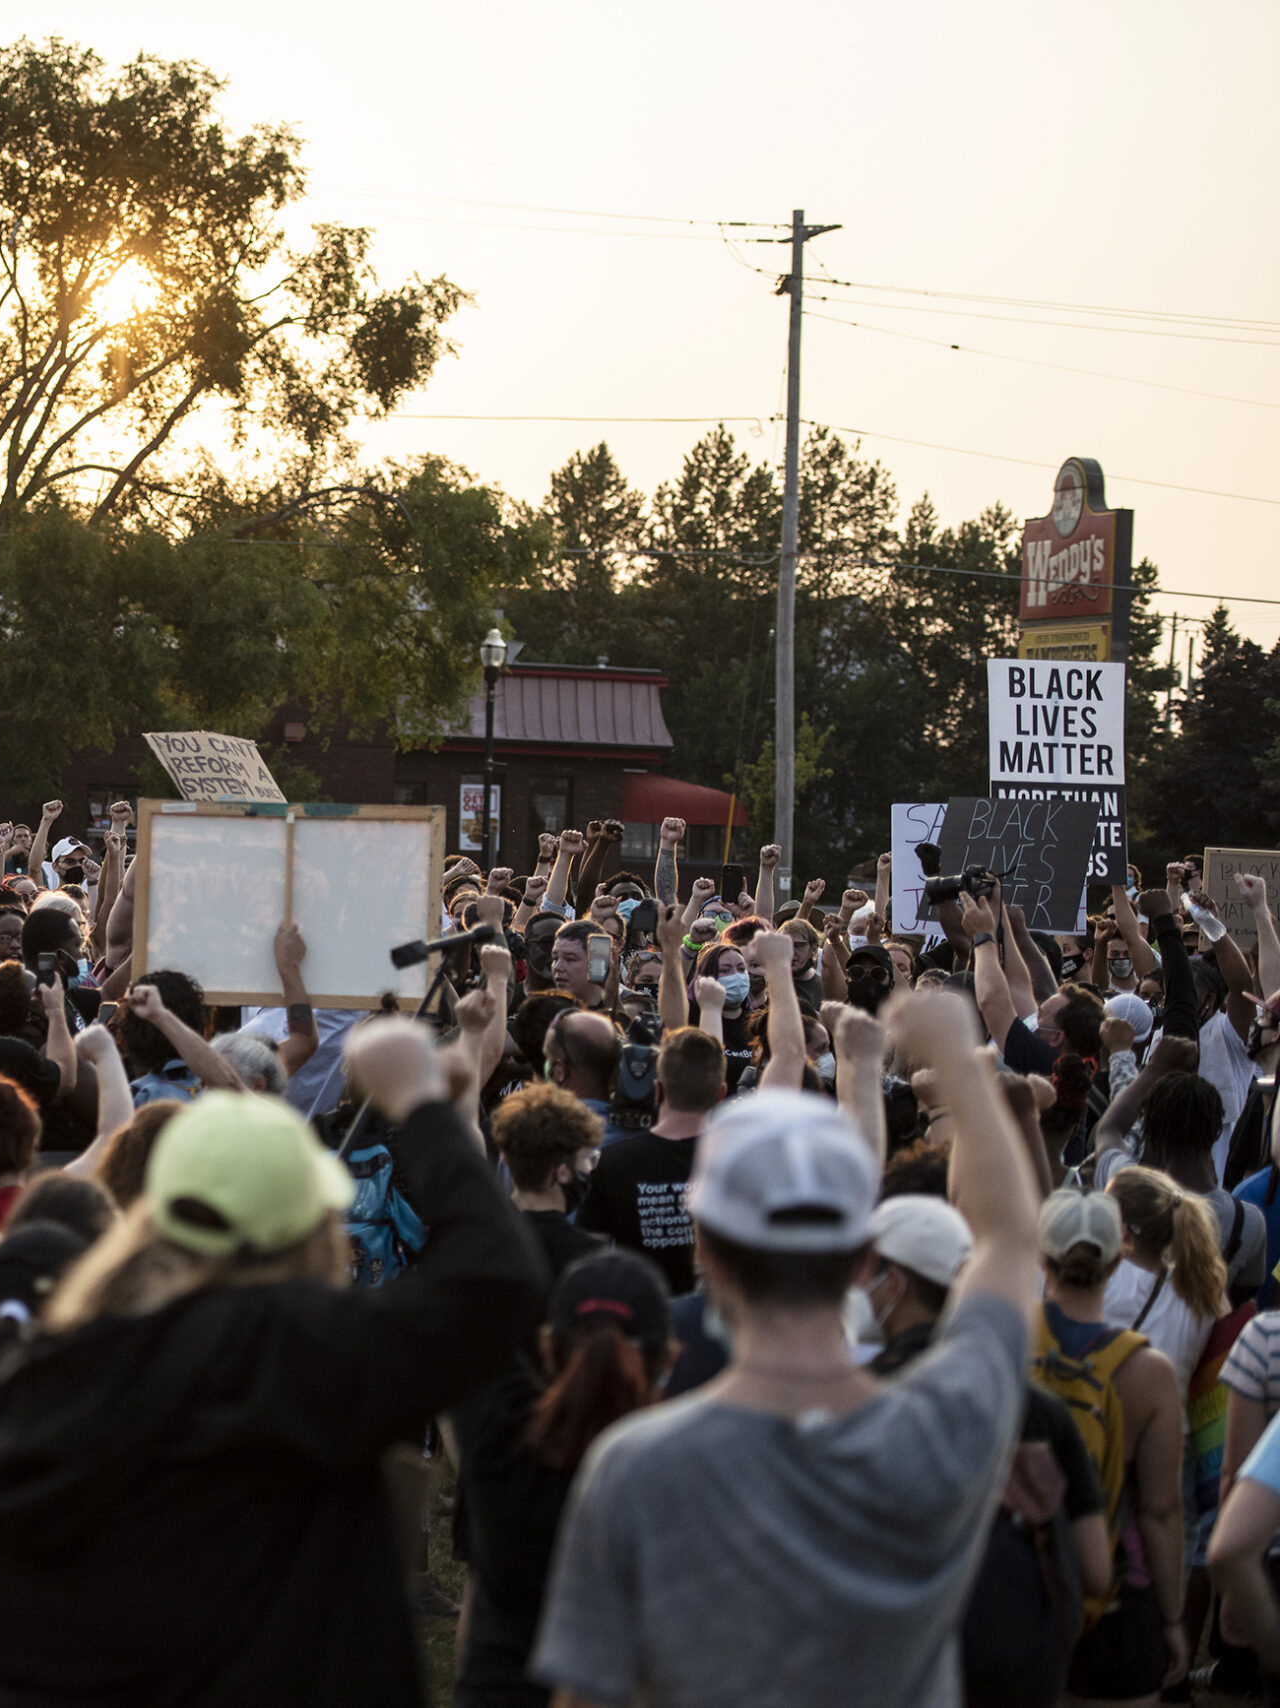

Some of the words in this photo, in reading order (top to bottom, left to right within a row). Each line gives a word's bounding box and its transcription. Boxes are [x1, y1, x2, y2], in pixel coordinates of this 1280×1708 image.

[1009, 667, 1104, 701] BLACK
[1016, 704, 1098, 738] LIVES
[156, 734, 202, 753] YOU
[1000, 741, 1114, 776] MATTER
[171, 756, 251, 779] REFORM
[258, 766, 272, 784] A
[182, 777, 254, 797] SYSTEM
[968, 799, 1063, 842] BLACK
[637, 1183, 669, 1194] Your
[637, 1195, 675, 1206] mean
[638, 1207, 675, 1217] when
[640, 1215, 690, 1226] actions
[641, 1227, 663, 1237] the
[643, 1236, 694, 1248] opposit
